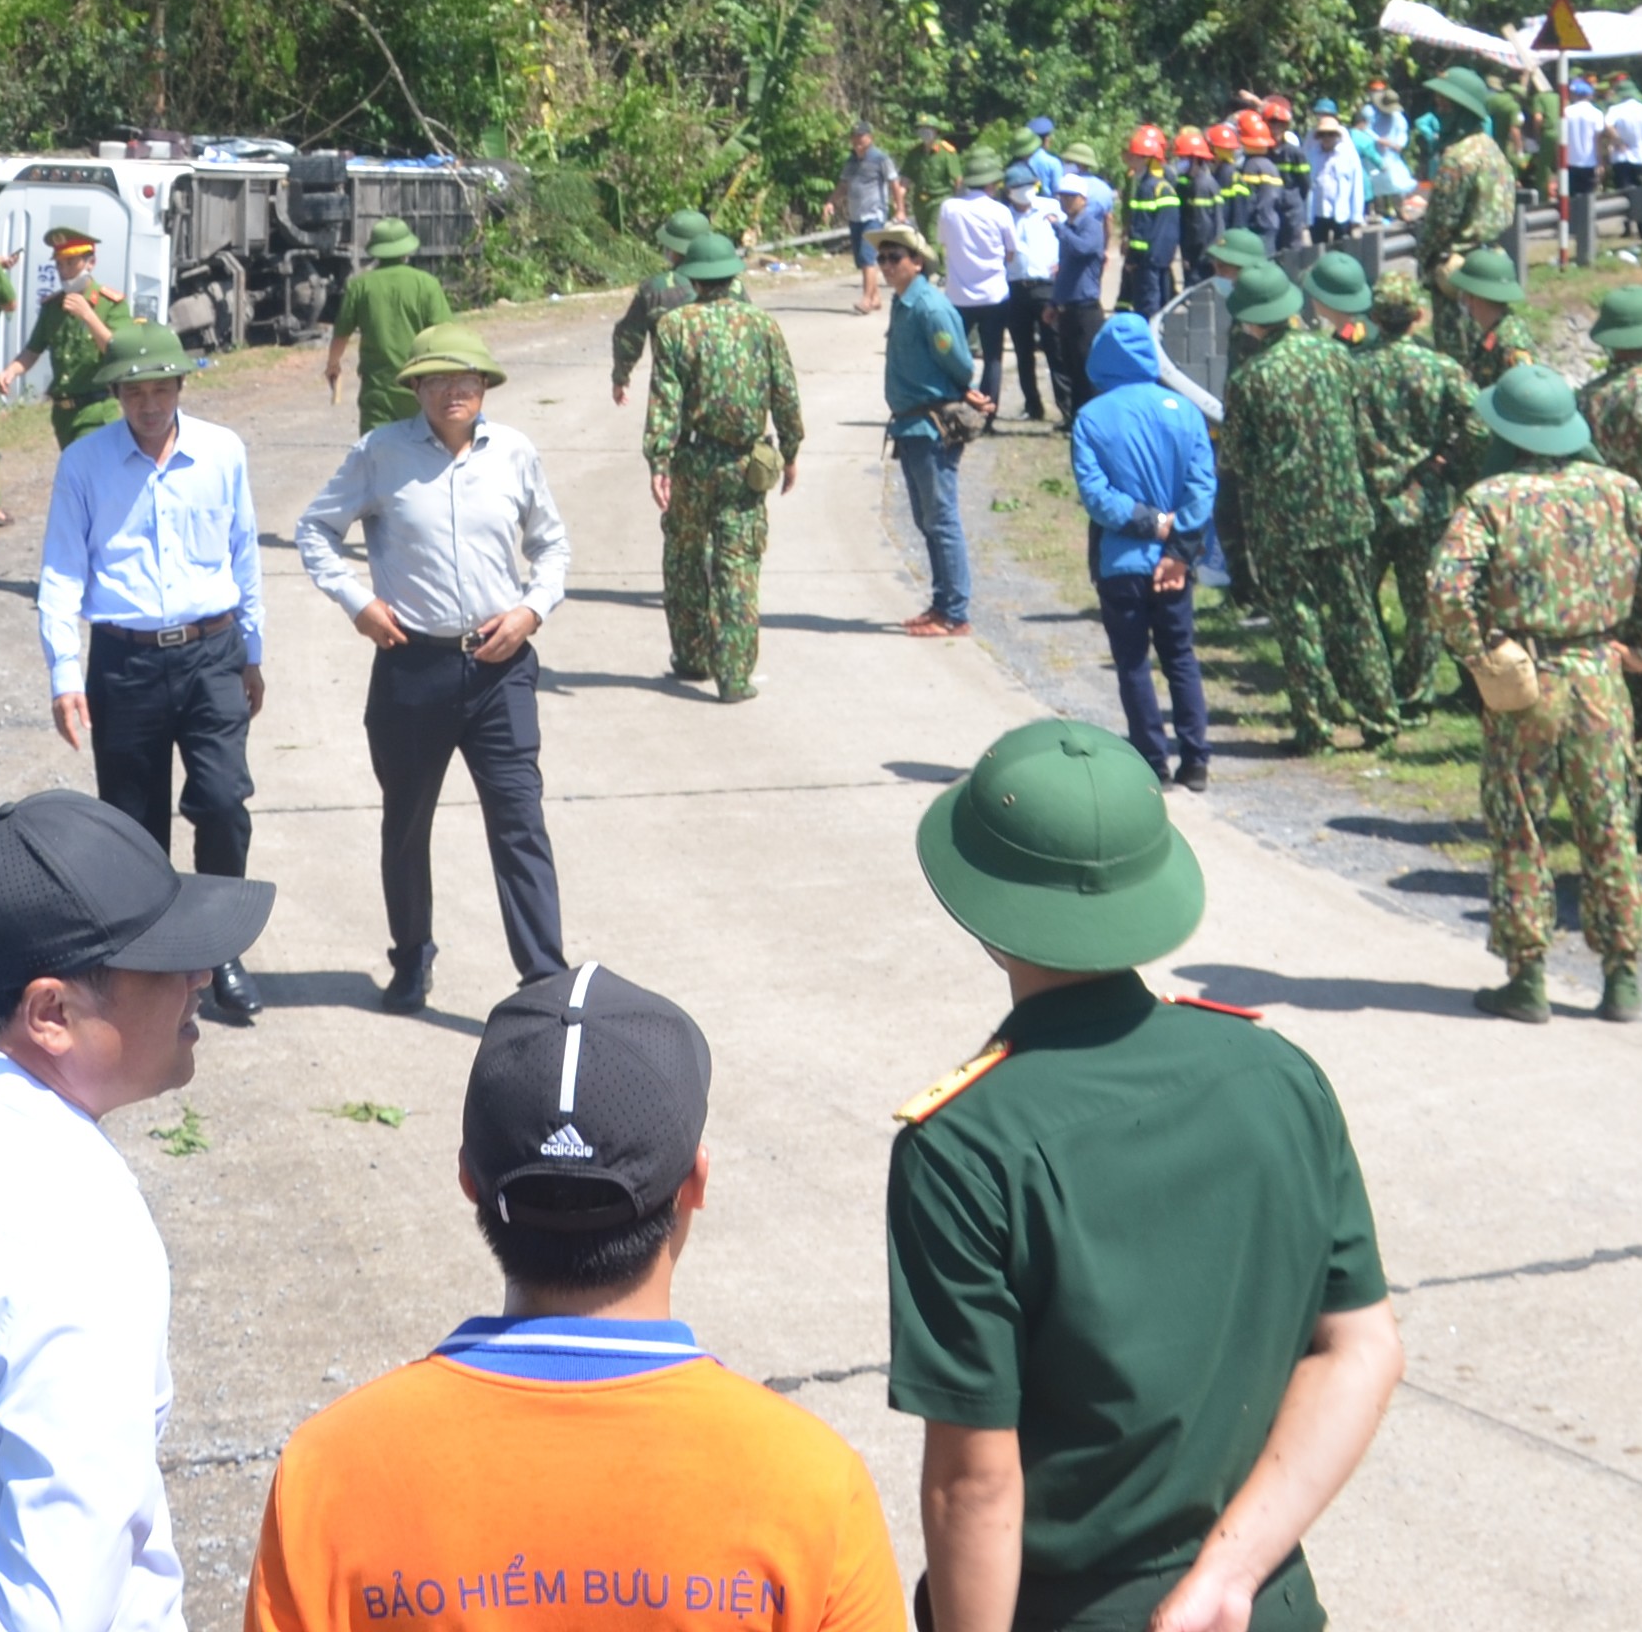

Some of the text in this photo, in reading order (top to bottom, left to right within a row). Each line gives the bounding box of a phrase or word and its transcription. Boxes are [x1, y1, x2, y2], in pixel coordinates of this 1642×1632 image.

[363, 1554, 785, 1620] BẢO HIỂM BƯU ĐIỆN
